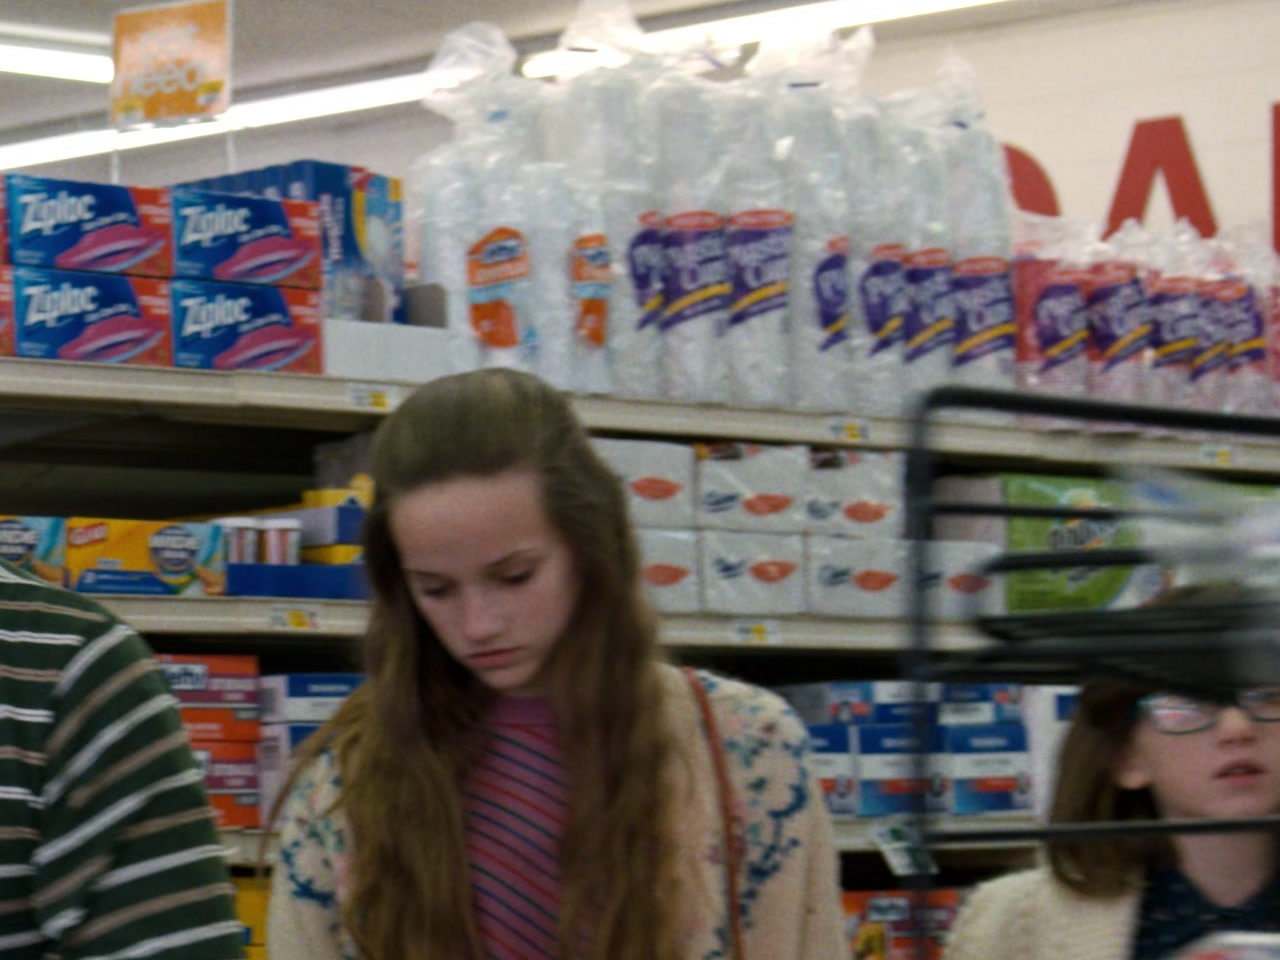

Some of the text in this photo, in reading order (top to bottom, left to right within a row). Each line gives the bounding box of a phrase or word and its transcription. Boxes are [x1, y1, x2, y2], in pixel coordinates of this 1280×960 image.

[17, 190, 97, 236] Ziploc
[179, 203, 251, 248] Ziploc
[22, 282, 100, 328] Ziploc
[179, 294, 252, 338] Ziploc
